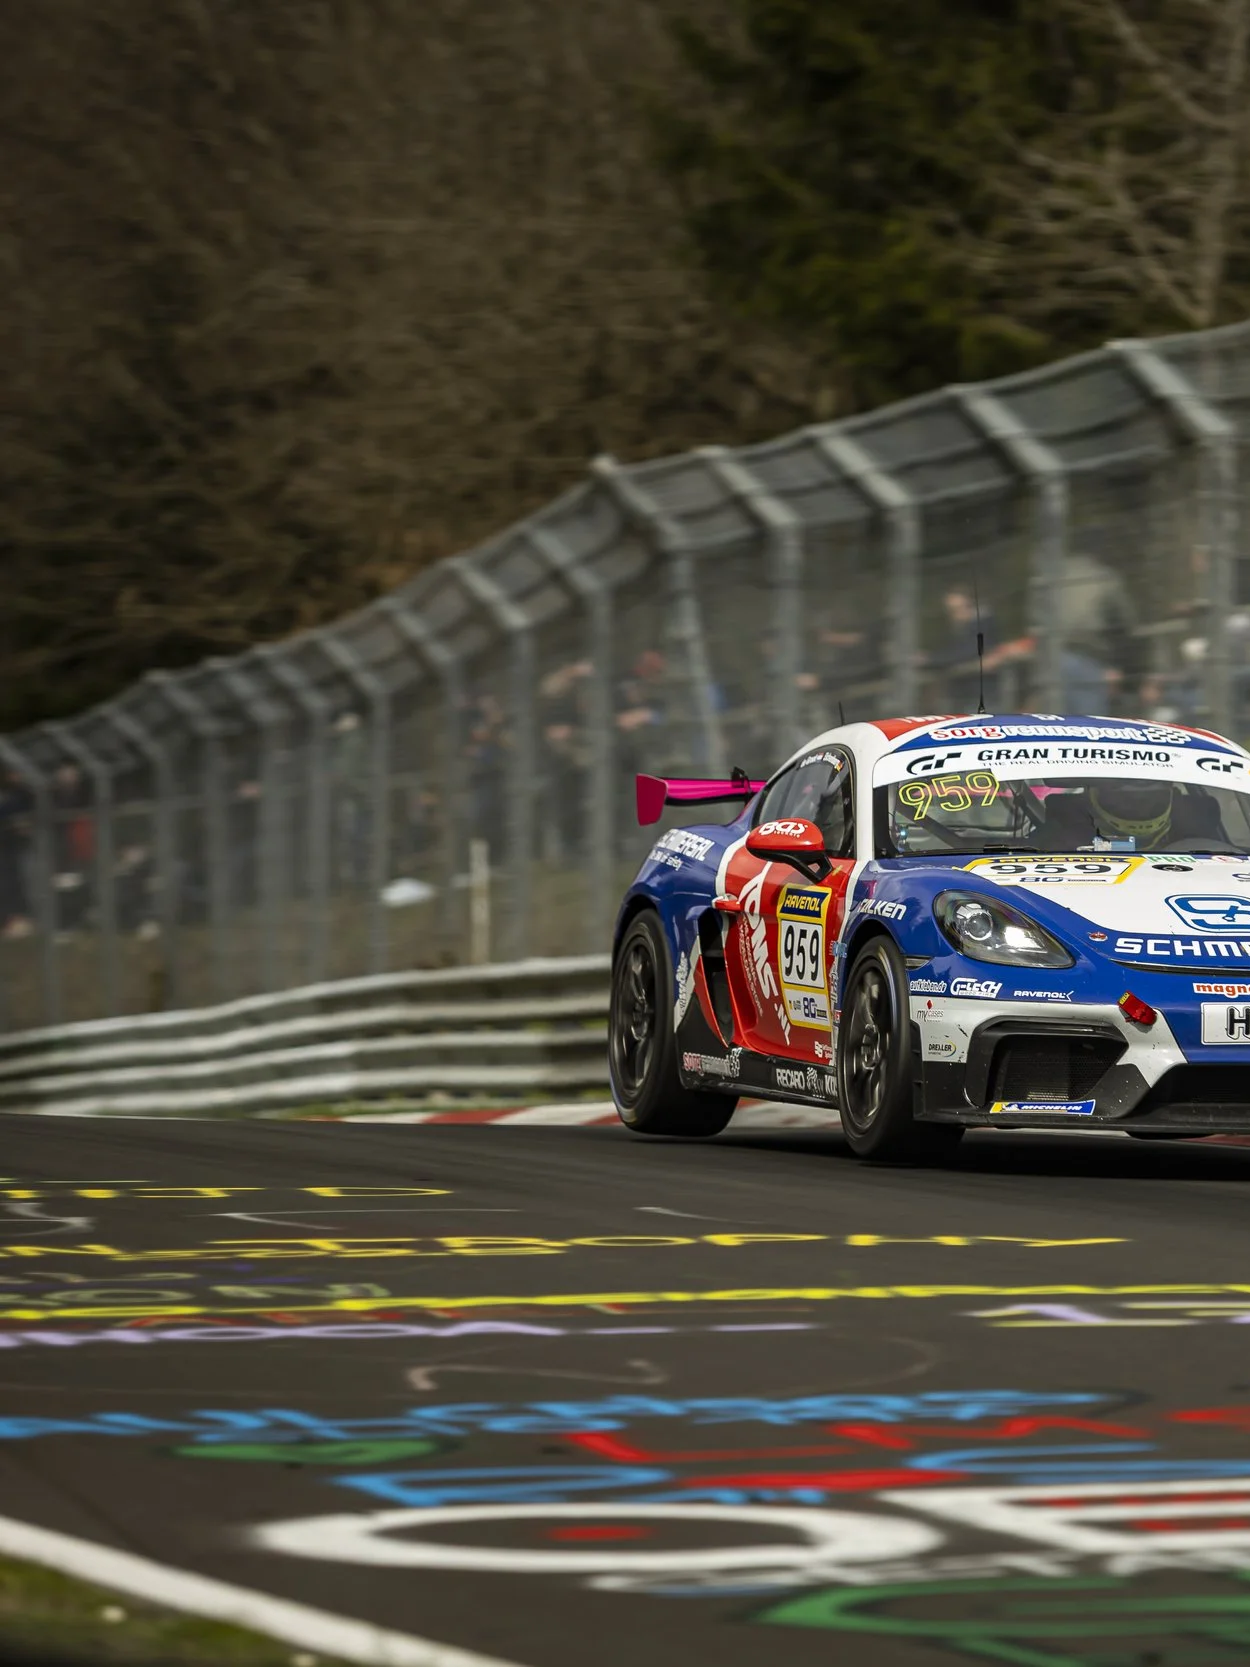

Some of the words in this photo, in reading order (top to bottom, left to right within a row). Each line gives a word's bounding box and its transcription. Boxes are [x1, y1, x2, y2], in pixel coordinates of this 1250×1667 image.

[977, 748, 1048, 761] GRAN
[1058, 748, 1171, 763] TURISMO
[1102, 760, 1174, 768] SIMULATOR
[899, 771, 1000, 820] 959
[990, 863, 1112, 875] 959
[784, 894, 821, 911] RAVENOL
[783, 925, 821, 982] 959
[1014, 990, 1068, 998] RAVENOL
[776, 1068, 805, 1091] RECARO
